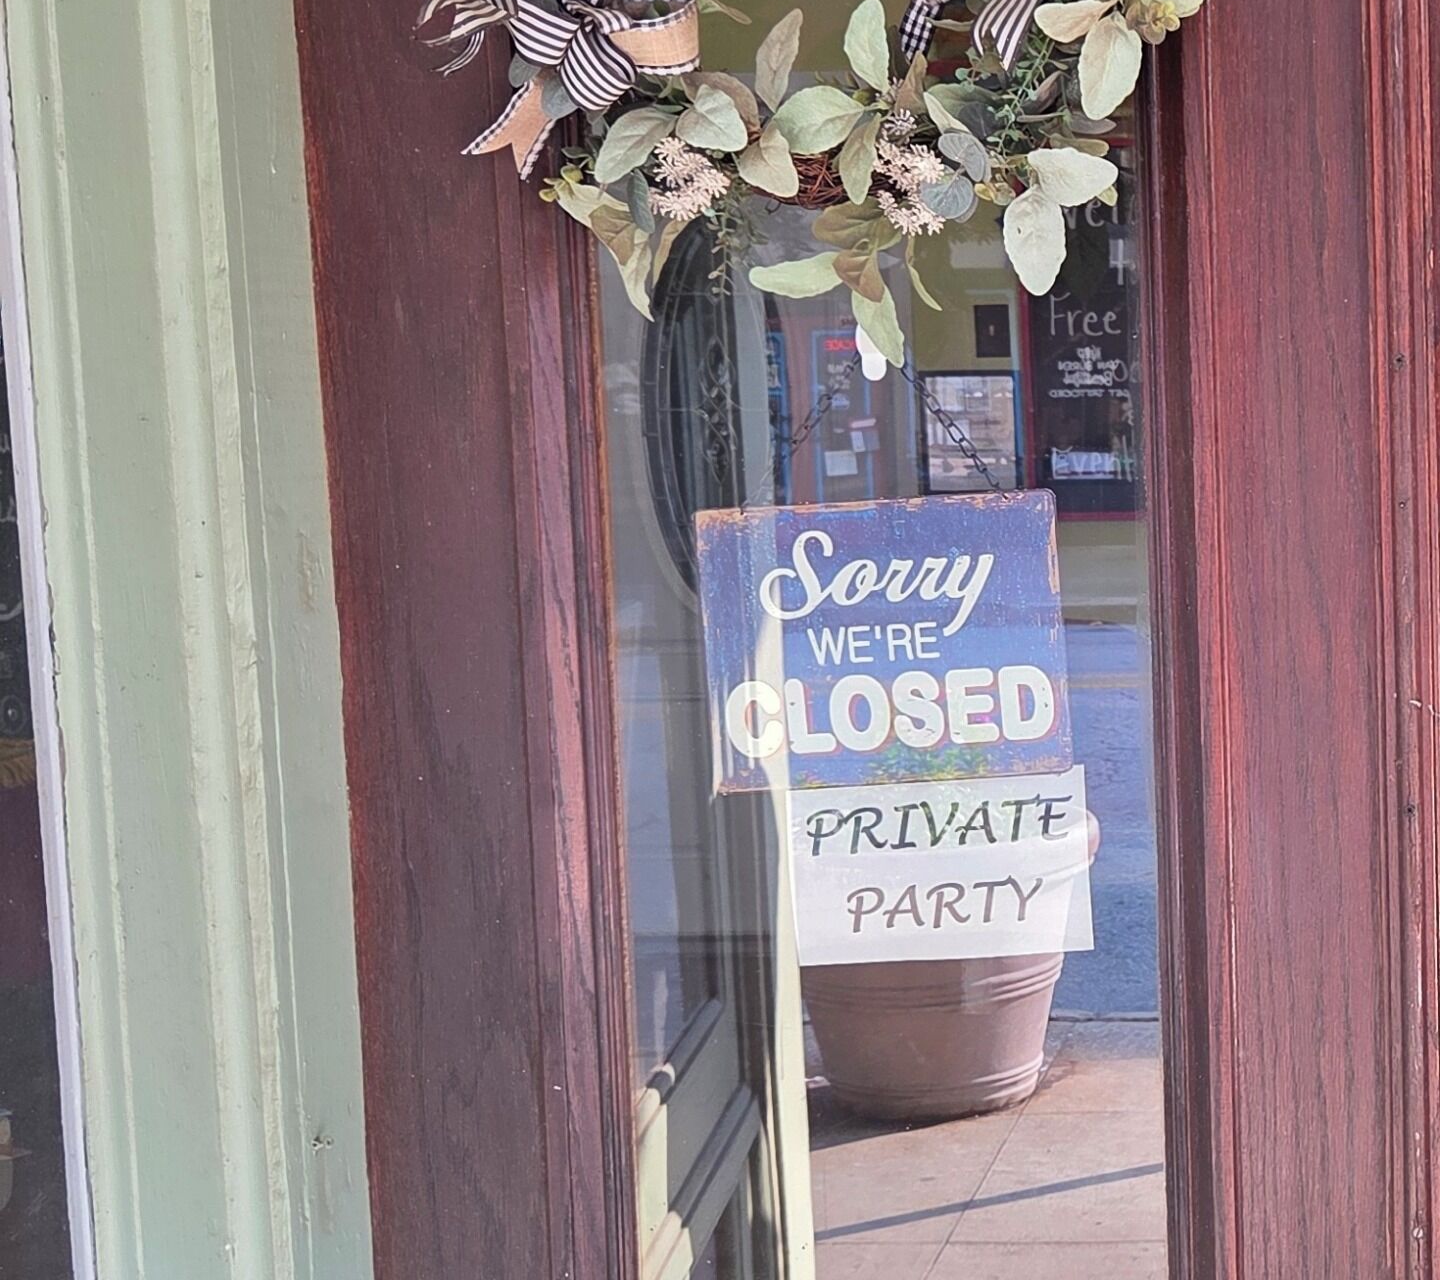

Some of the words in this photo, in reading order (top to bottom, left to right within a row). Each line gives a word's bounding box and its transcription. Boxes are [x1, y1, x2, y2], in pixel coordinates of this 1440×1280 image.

[1049, 293, 1122, 337] Free
[759, 530, 994, 636] Sorry
[807, 622, 941, 666] WE'RE
[725, 665, 1055, 758] CLOSED
[806, 792, 1073, 857] PRIVATE
[846, 875, 1044, 934] PARTY
